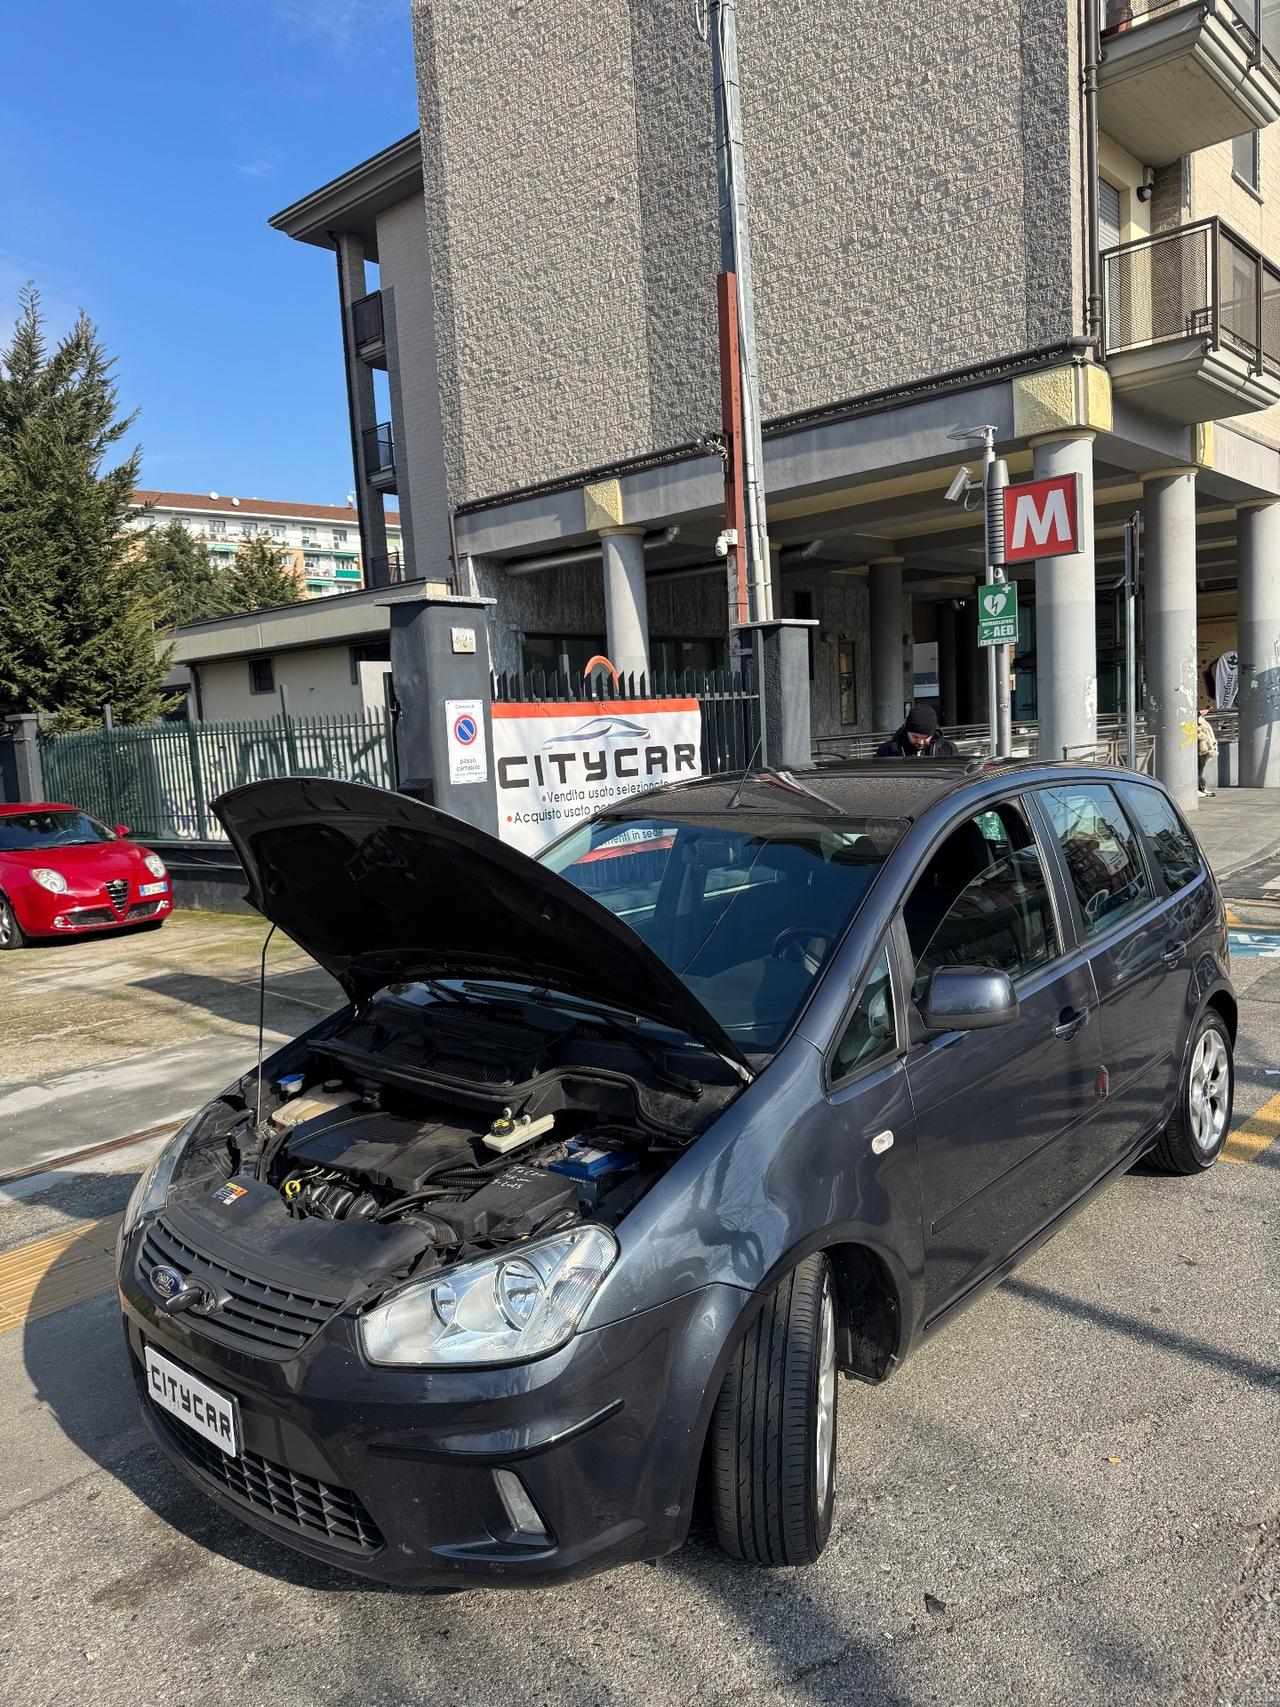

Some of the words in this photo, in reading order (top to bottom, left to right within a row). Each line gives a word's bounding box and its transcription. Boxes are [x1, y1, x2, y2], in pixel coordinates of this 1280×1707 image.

[1011, 488, 1072, 549] M
[993, 624, 1014, 637] AED
[497, 743, 696, 790] CITYCAR
[547, 789, 585, 803] Vendita
[588, 786, 614, 799] usato
[514, 807, 562, 825] Acquisto
[563, 804, 591, 818] usato
[632, 831, 641, 840] in
[642, 828, 664, 839] sede
[151, 1364, 232, 1442] CITYCAR
